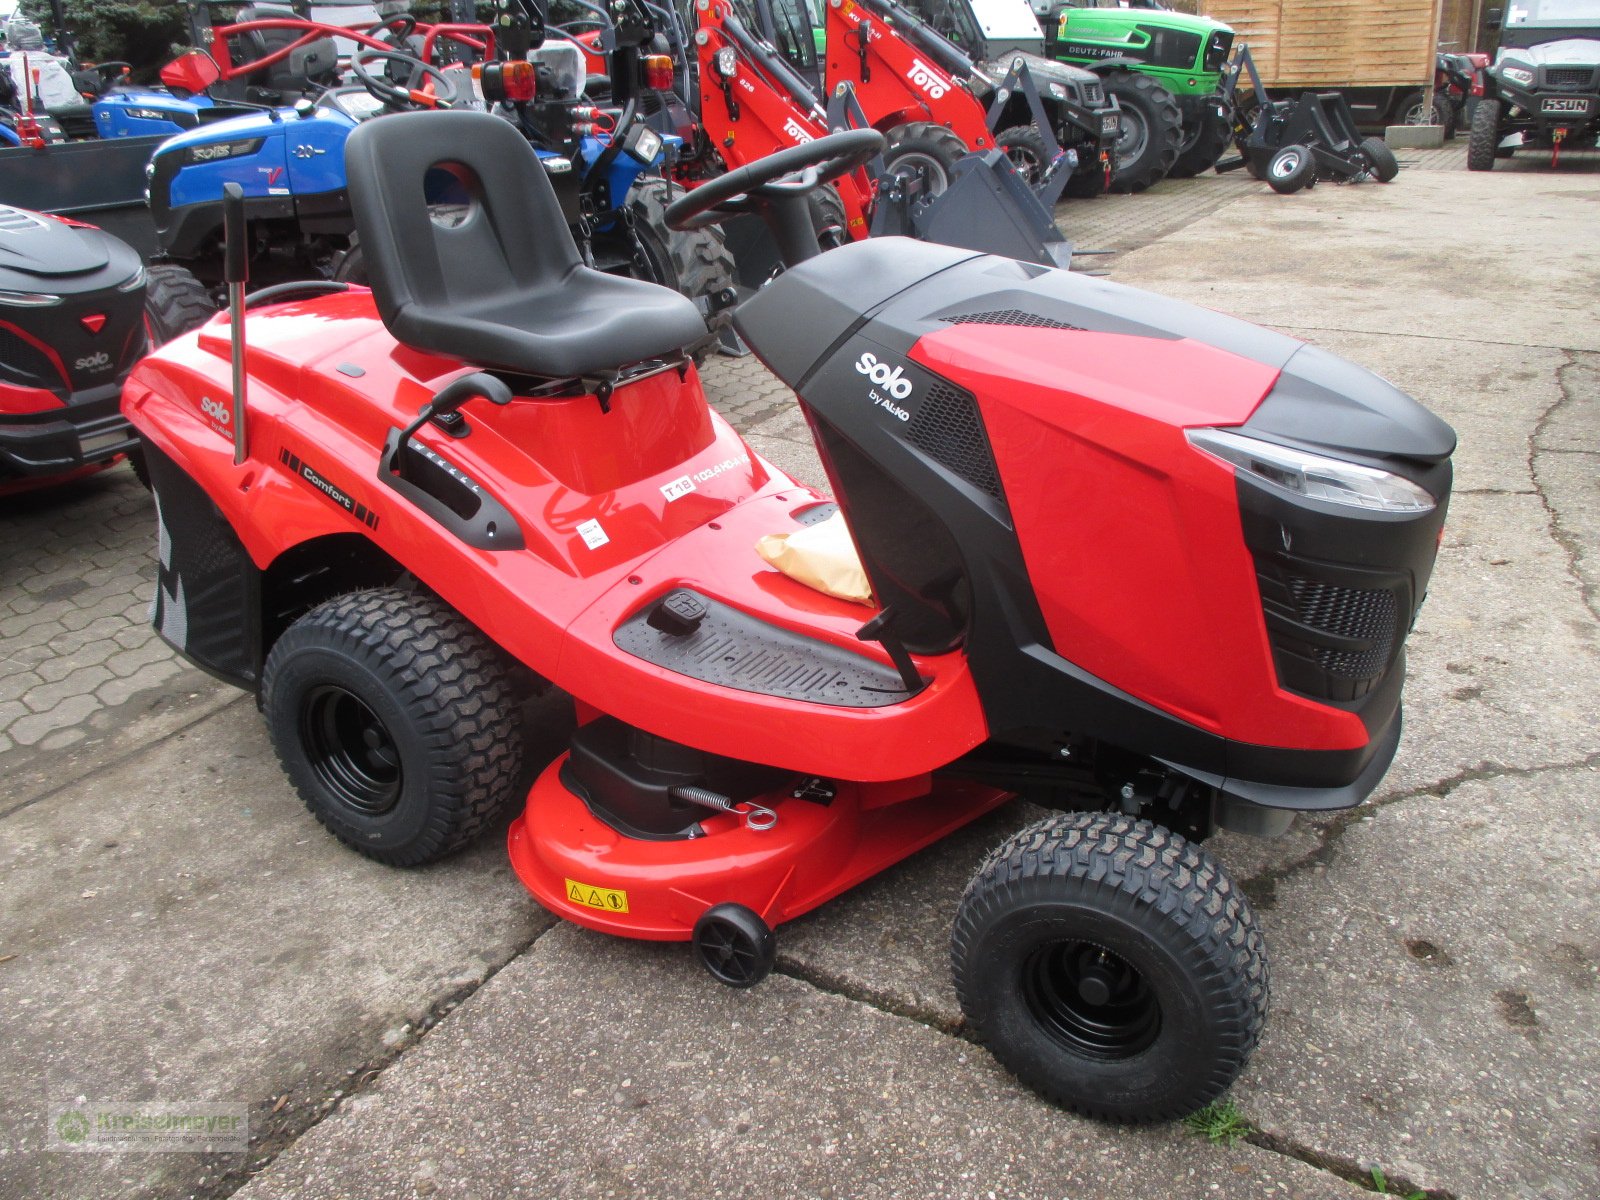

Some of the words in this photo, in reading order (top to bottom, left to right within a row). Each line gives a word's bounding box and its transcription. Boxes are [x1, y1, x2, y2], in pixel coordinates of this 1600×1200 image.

[740, 78, 755, 93] 826
[906, 58, 952, 99] TOYO
[75, 351, 109, 370] solo
[855, 352, 913, 400] solo
[868, 388, 883, 405] by
[201, 396, 230, 425] solo
[303, 466, 352, 509] Comfort
[664, 486, 675, 498] T
[675, 479, 692, 493] 18
